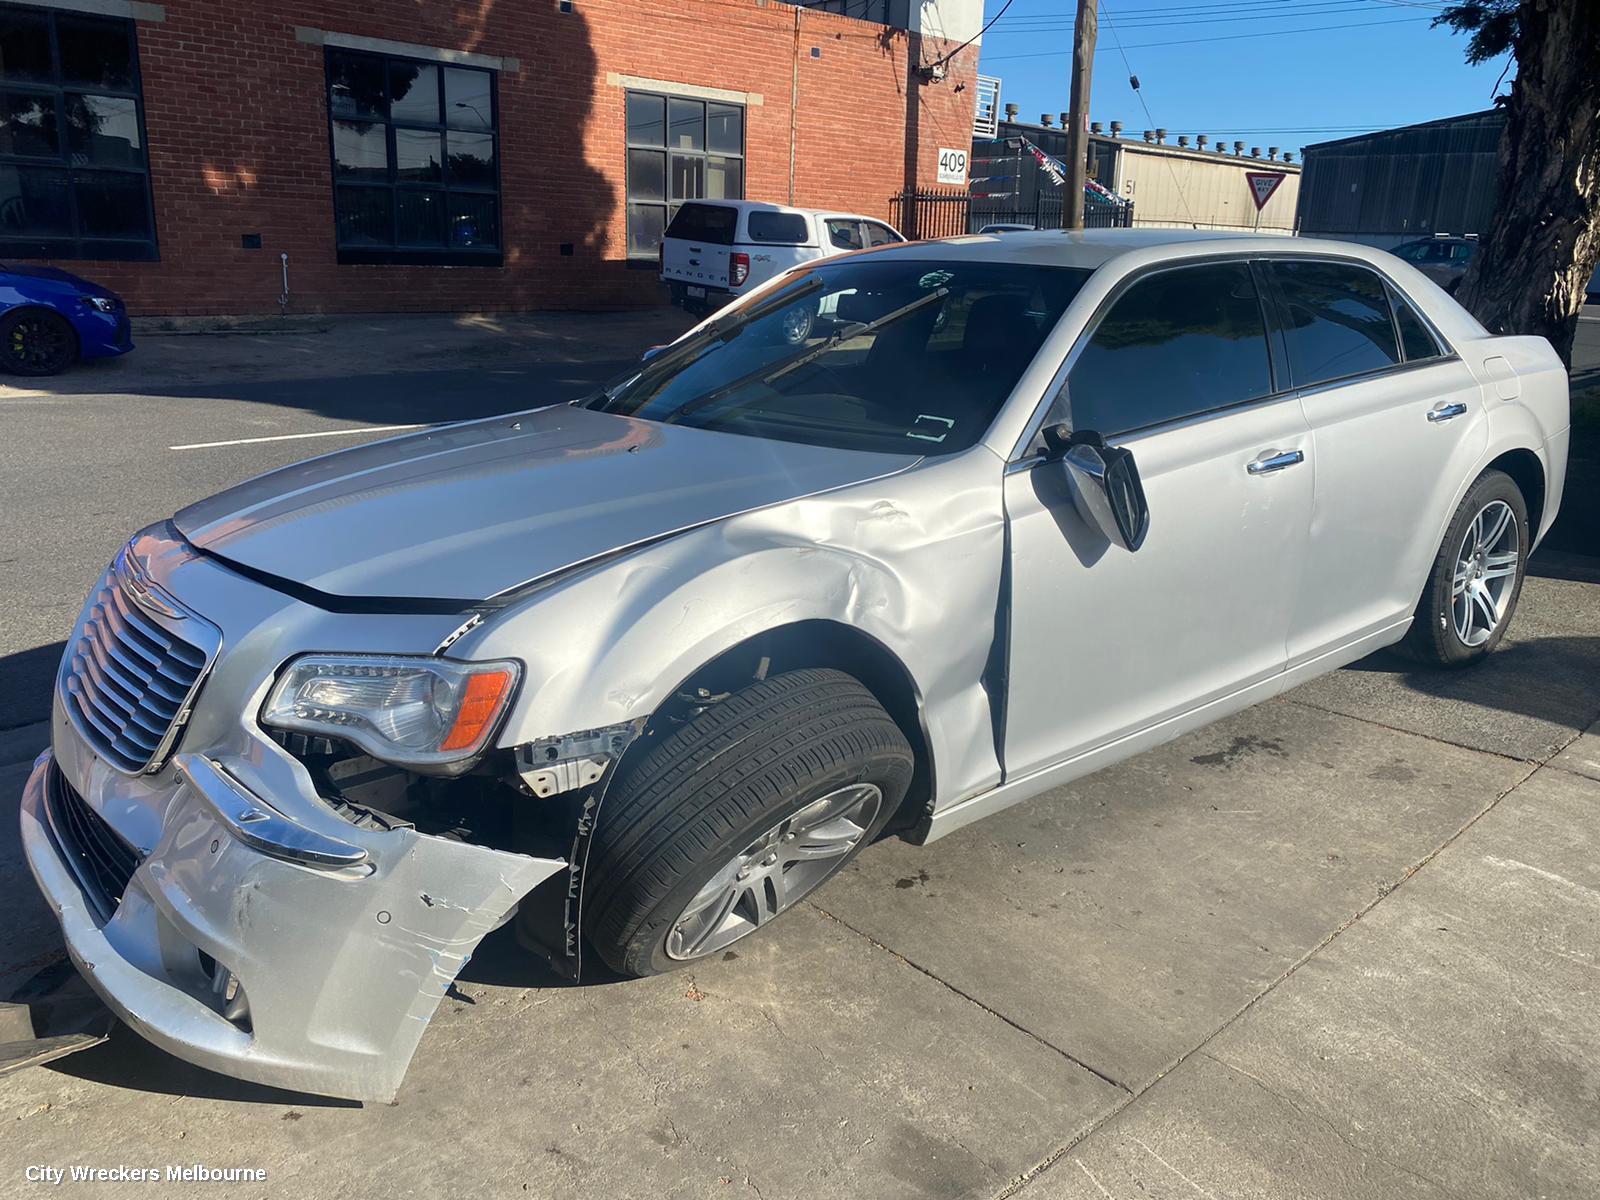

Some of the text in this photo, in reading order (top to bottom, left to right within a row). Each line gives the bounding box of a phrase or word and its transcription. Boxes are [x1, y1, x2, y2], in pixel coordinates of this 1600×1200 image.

[940, 152, 966, 173] 409
[1125, 179, 1136, 195] 51
[1255, 179, 1275, 187] GIVE
[665, 267, 728, 282] RANGER
